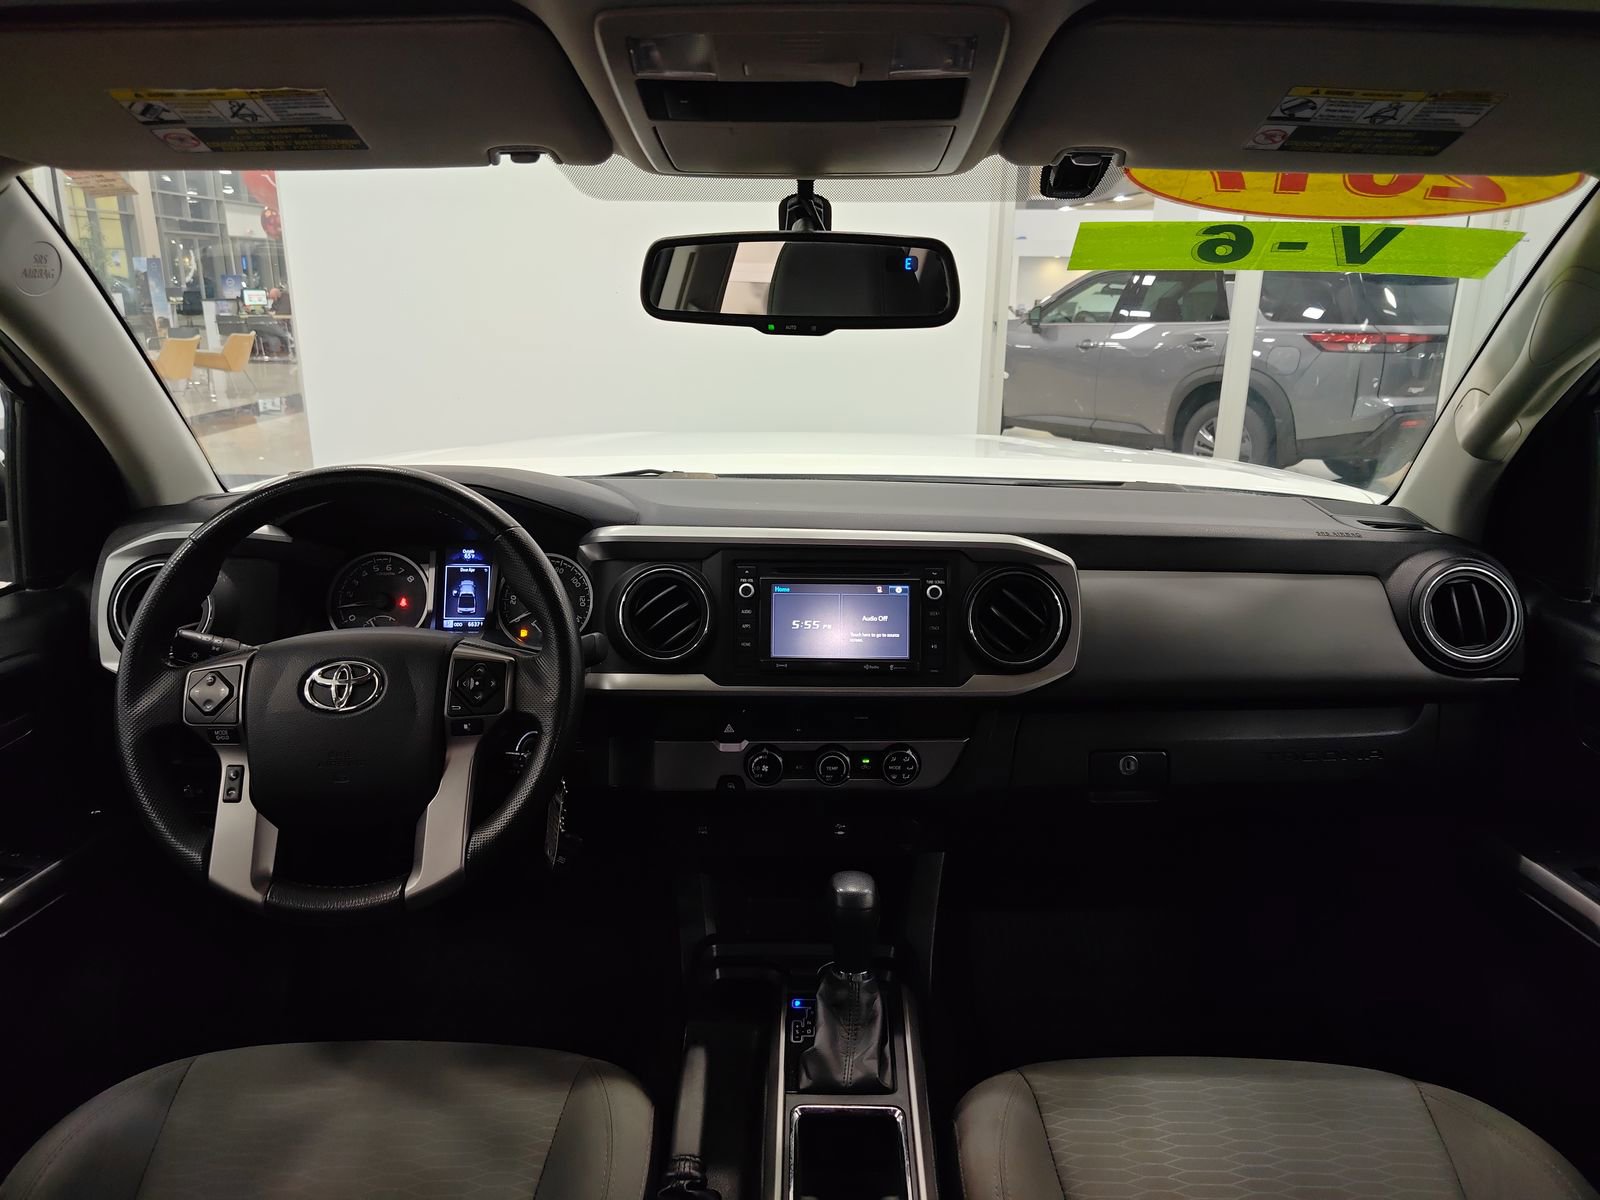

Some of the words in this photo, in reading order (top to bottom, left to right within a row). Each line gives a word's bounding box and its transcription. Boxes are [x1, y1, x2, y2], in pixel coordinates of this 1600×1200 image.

[905, 257, 912, 270] E
[774, 585, 791, 593] Home
[791, 620, 821, 630] 5:55
